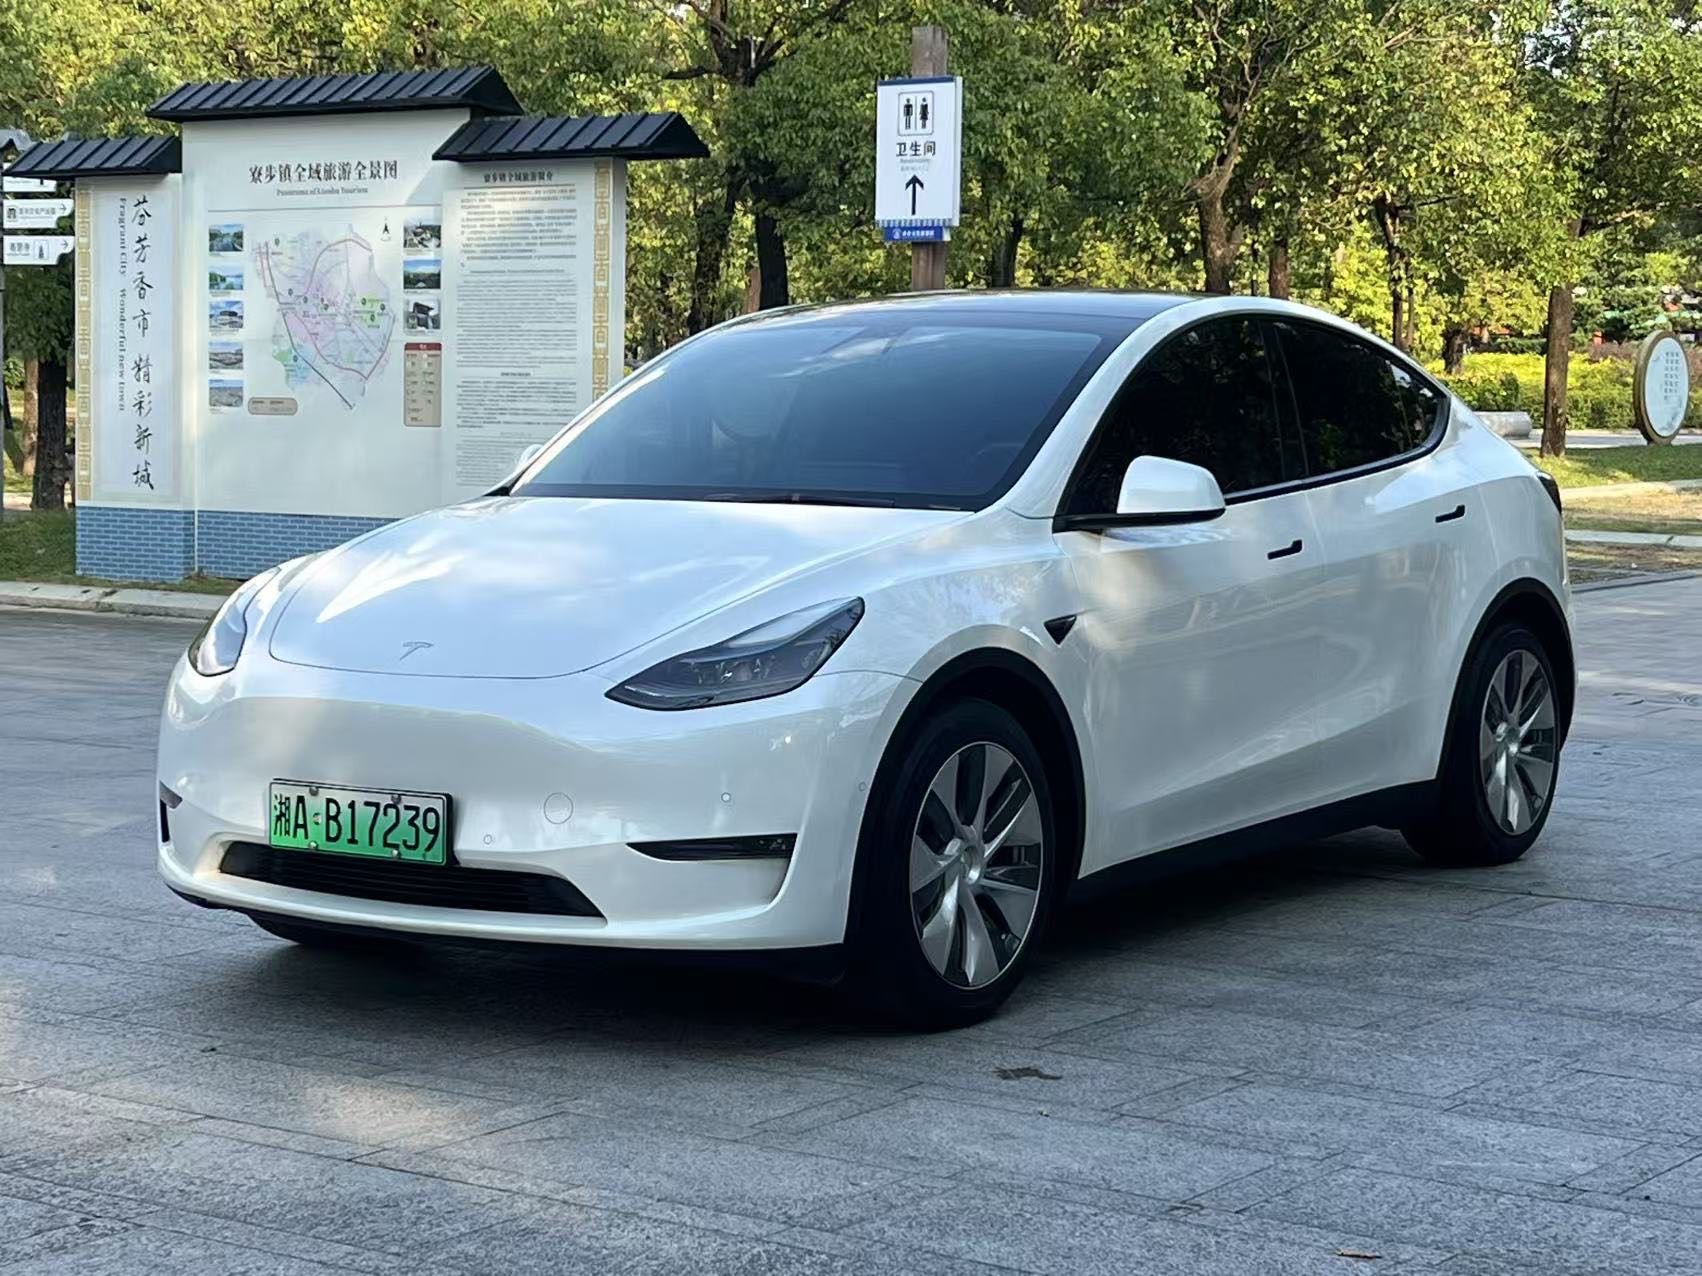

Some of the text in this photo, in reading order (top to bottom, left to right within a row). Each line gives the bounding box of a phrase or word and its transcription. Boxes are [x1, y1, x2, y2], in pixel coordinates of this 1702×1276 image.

[896, 141, 936, 157] 卫生间
[249, 160, 398, 184] 寮步镇全域旅游全景图
[118, 198, 127, 249] Fragrant
[118, 251, 128, 275] City
[131, 195, 154, 338] 芬芳香市
[119, 288, 127, 352] Wonderful
